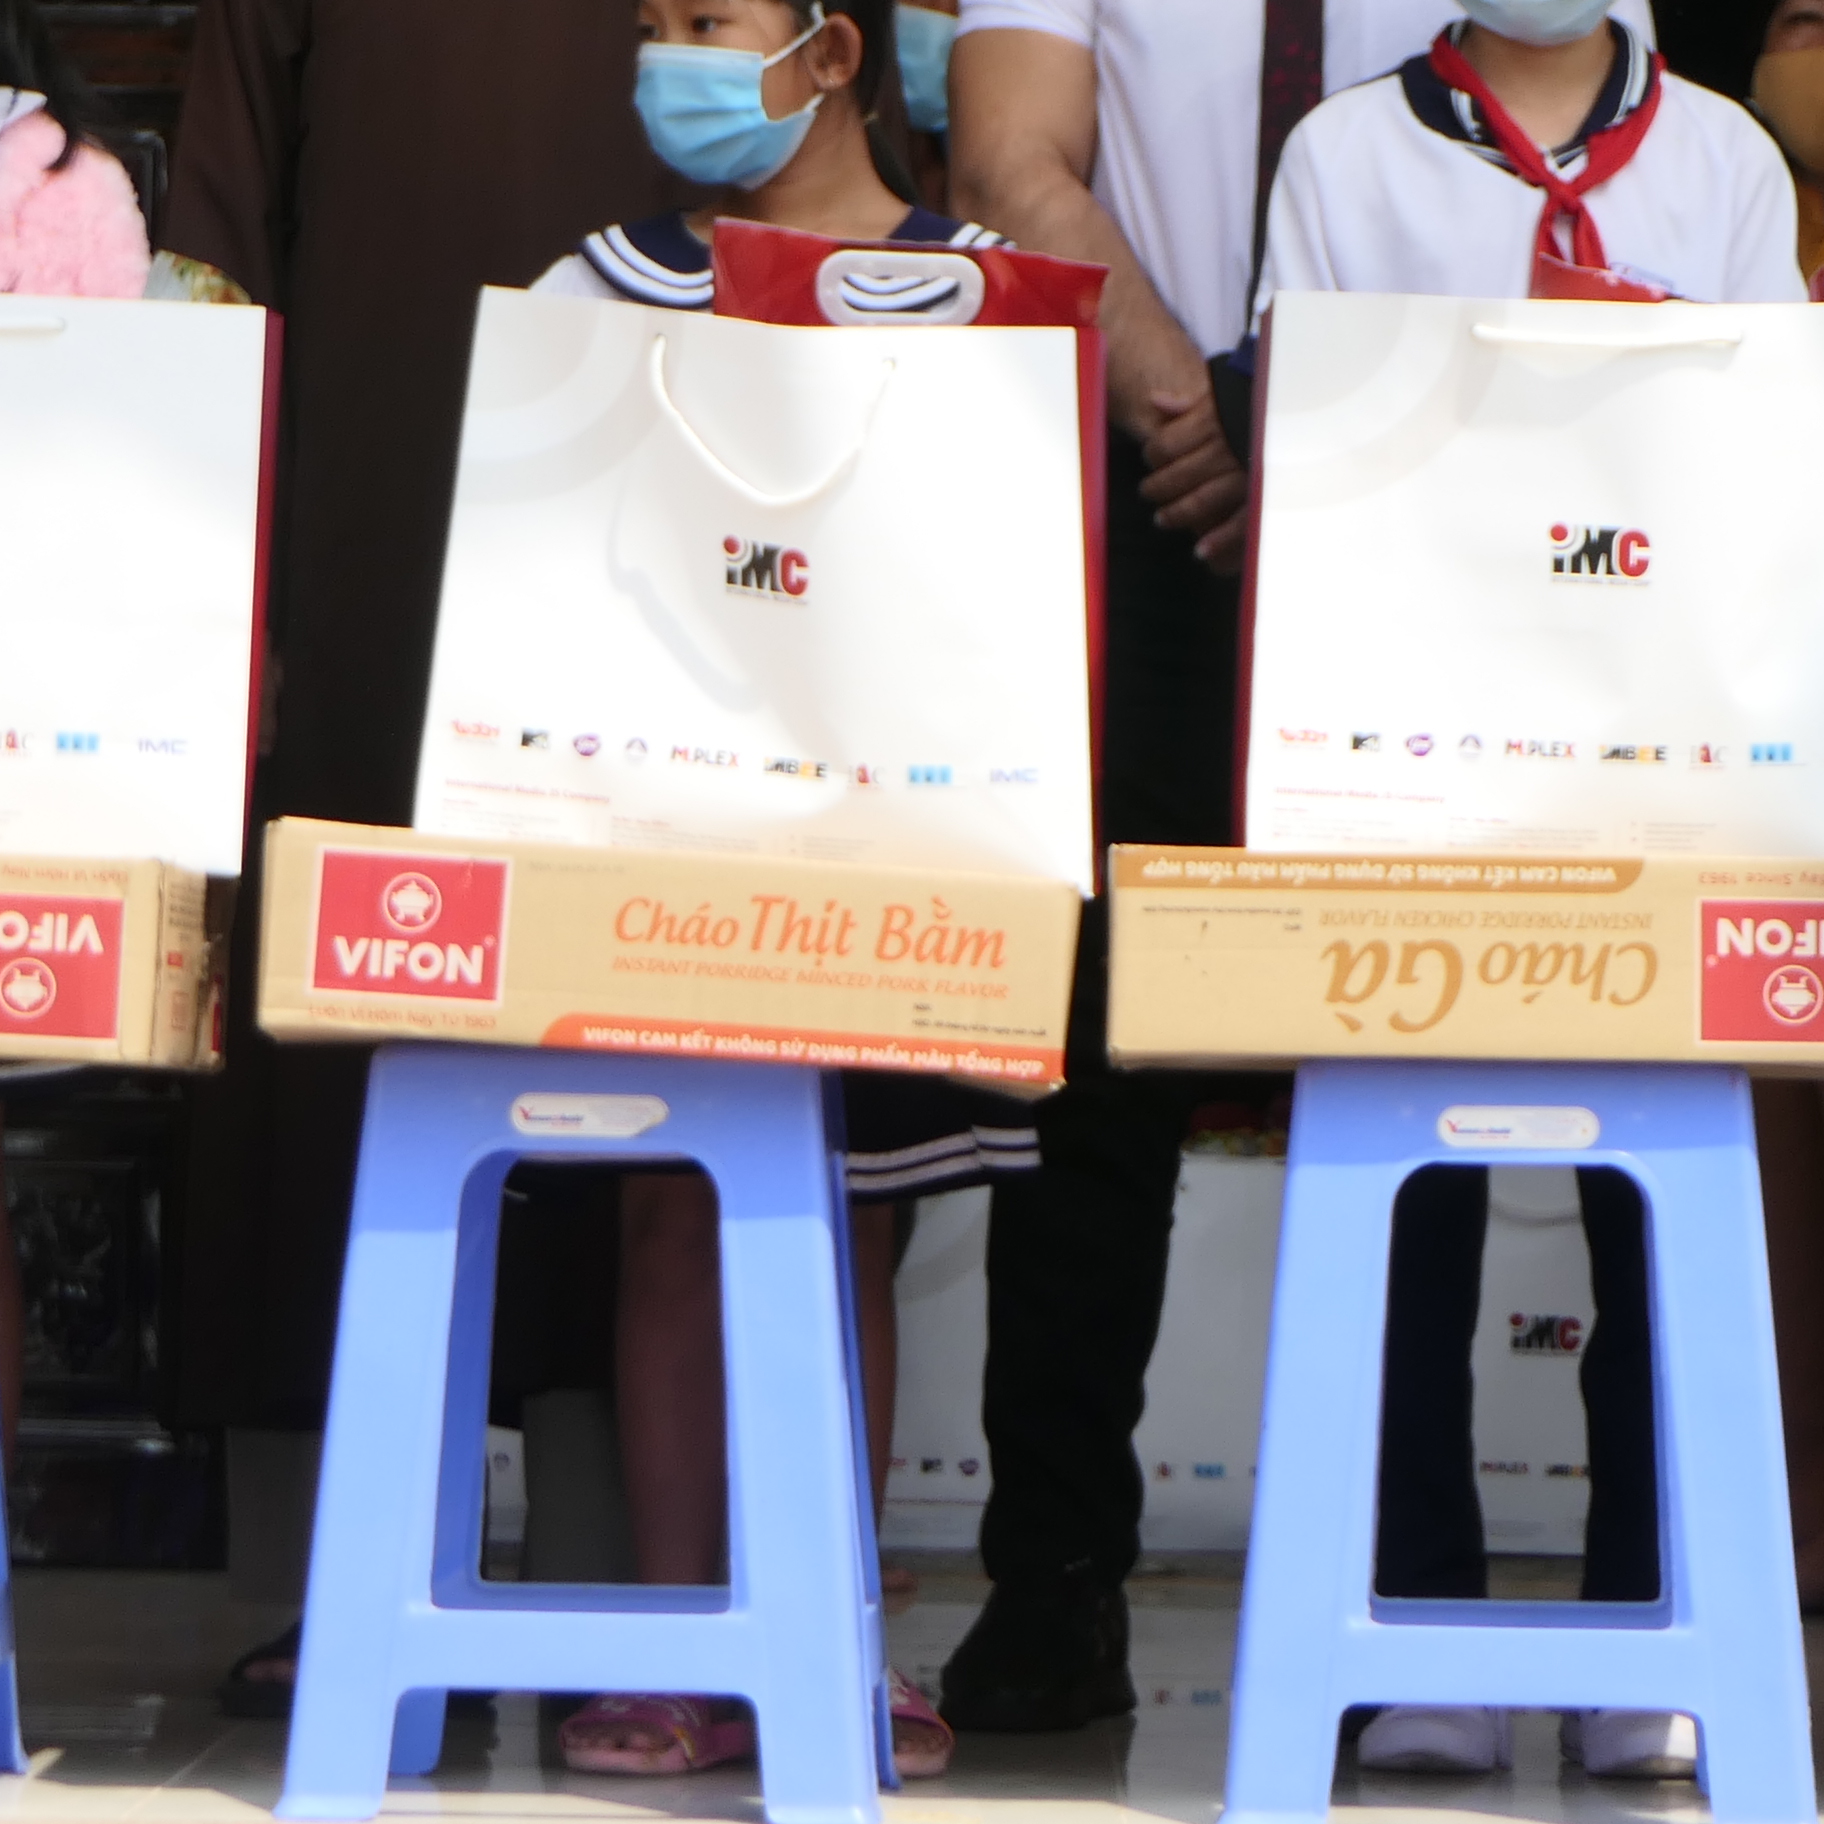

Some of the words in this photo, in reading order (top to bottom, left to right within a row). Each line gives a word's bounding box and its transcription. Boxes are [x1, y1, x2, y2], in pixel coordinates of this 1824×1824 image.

[333, 935, 484, 984] VIFON
[615, 896, 740, 949] Cháo
[750, 895, 859, 967] Thịt
[1319, 937, 1464, 1034] Gà
[1478, 941, 1659, 1007] Cháo
